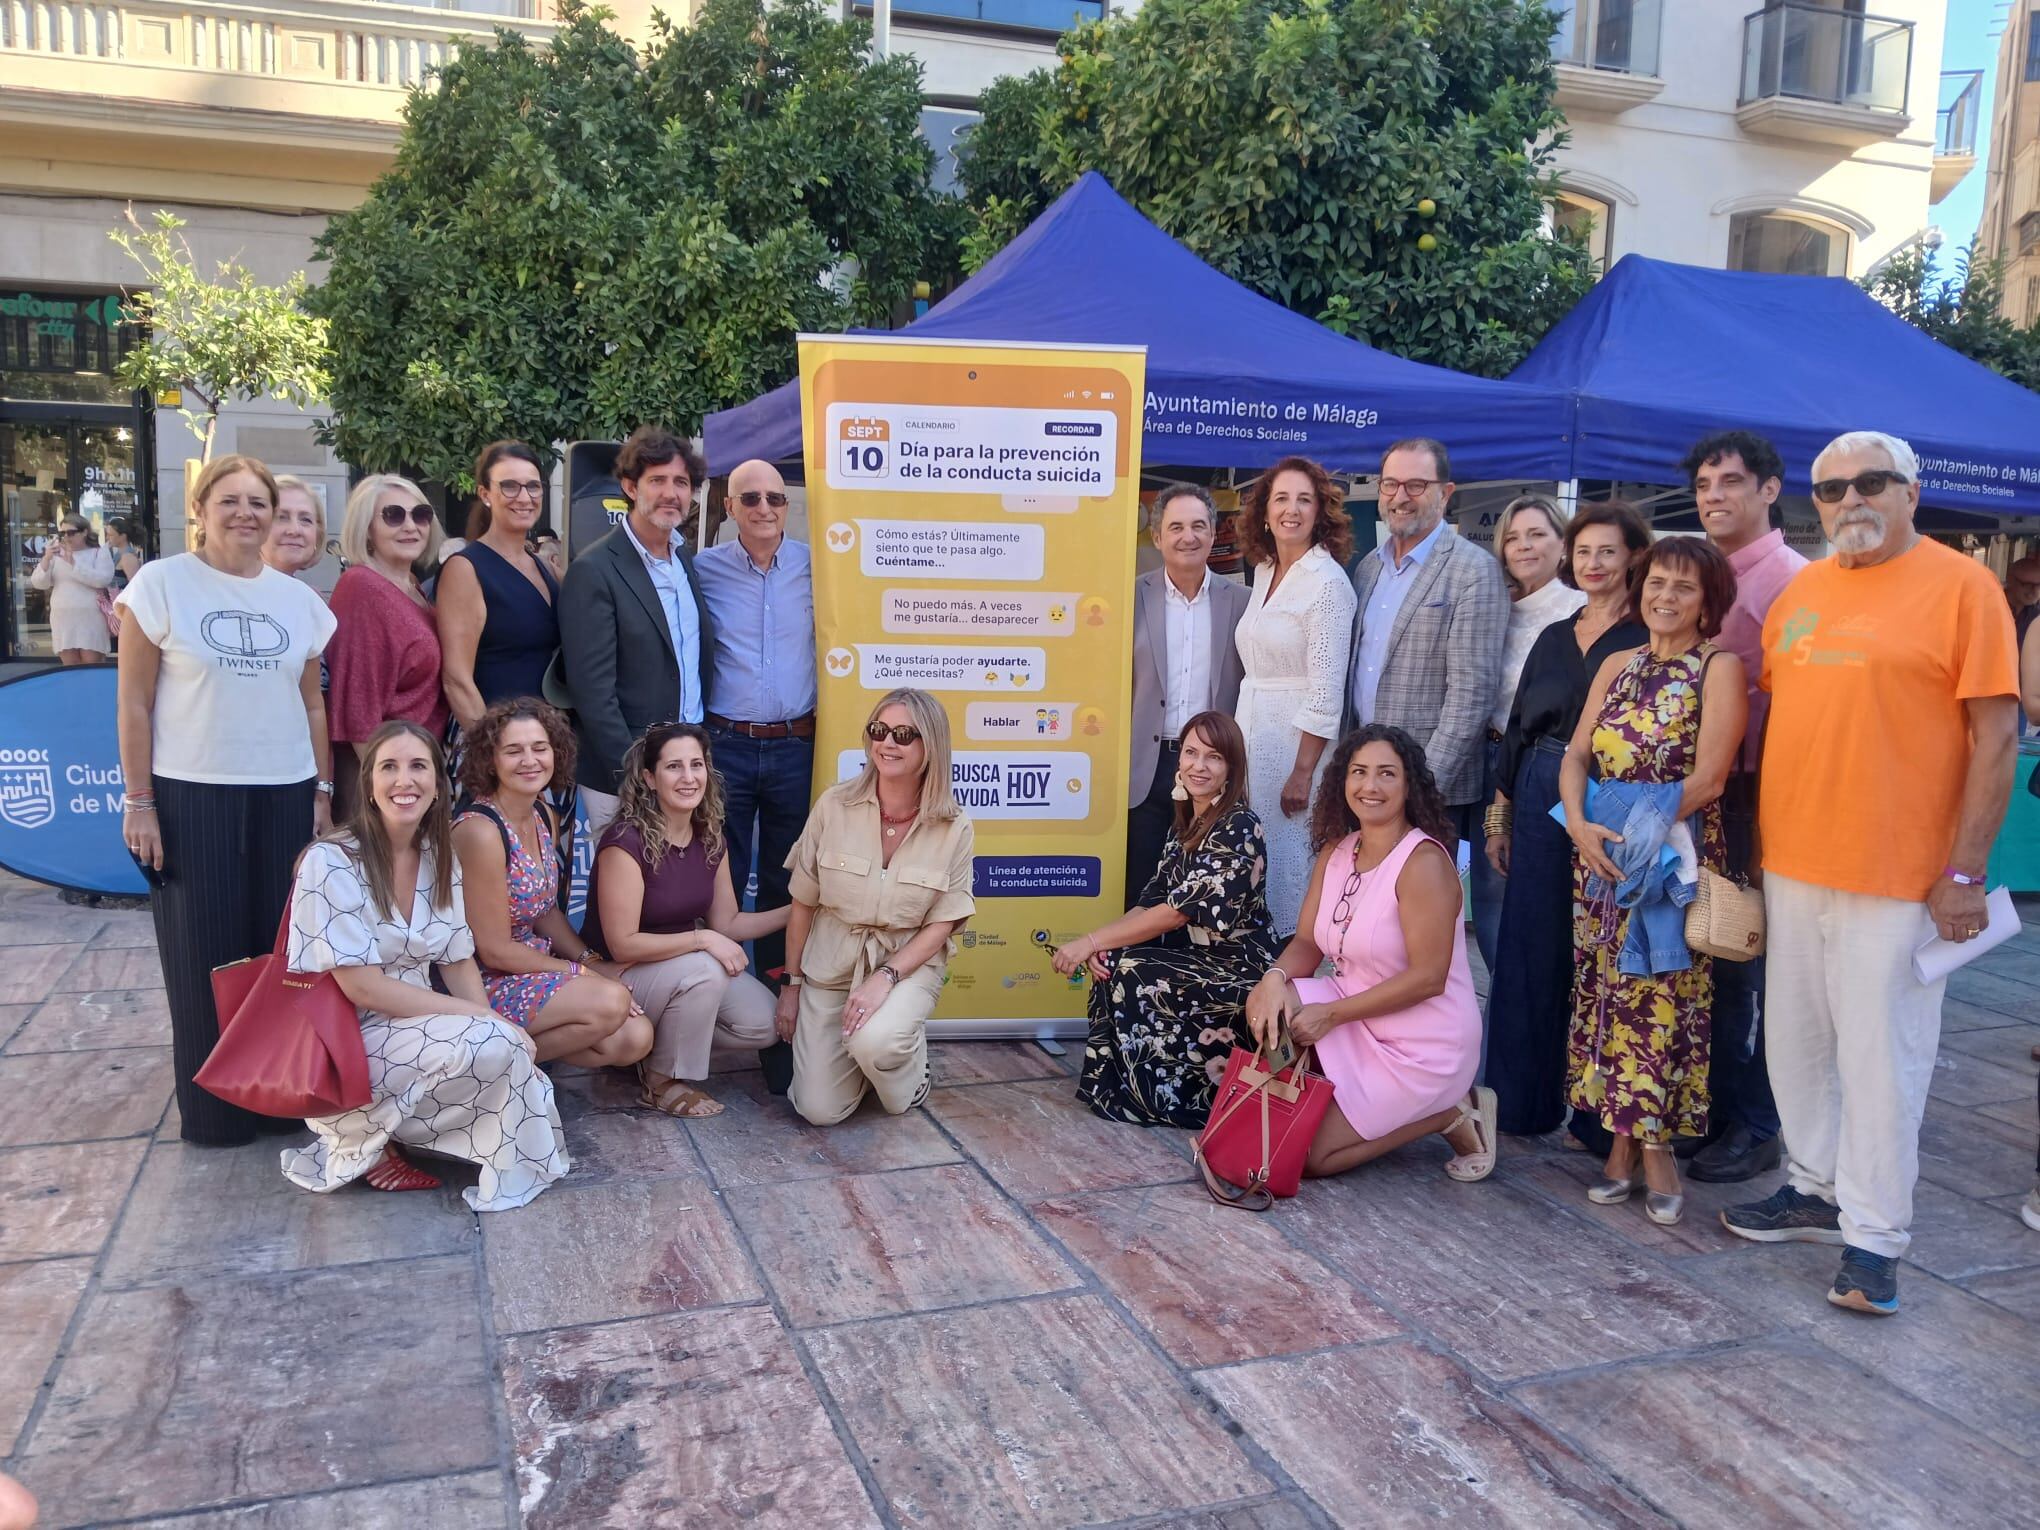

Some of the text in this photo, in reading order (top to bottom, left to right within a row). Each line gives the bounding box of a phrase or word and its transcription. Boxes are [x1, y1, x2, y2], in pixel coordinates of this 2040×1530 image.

[0, 293, 77, 319] efour
[37, 320, 75, 343] city
[1144, 391, 1378, 428] Ayuntamiento de Málaga
[847, 425, 883, 438] SEPT
[905, 421, 956, 430] CALENDARIO
[1052, 425, 1095, 434] RECORDAR
[1143, 416, 1308, 442] Área de Derechos Sociales
[846, 446, 884, 471] 10
[900, 441, 1100, 463] Día para la prevención
[900, 463, 1101, 482] de la conducta suicida
[2001, 466, 2017, 481] de
[1930, 479, 1941, 489] de
[1943, 479, 1981, 494] Derechos
[1982, 483, 2015, 498] Sociales
[875, 529, 1020, 543] Cómo estás? Últimamente
[875, 543, 1006, 558] siento que te pasa algo.
[875, 556, 945, 568] Cuéntame...
[894, 599, 1022, 611] No puedo más. A veces
[894, 613, 1039, 626] me gustaría... desaparecer
[216, 656, 281, 671] TWINSET
[874, 654, 1031, 668] Me gustaría poder ayudarte.
[874, 667, 965, 679] ¿Qué necesitas?
[983, 717, 1021, 727] Hablar
[65, 763, 127, 786] Ciud
[952, 763, 1051, 799] BUSCA HOY
[69, 792, 127, 814] de M
[952, 788, 1001, 807] AYUDA
[988, 865, 1087, 876] Línea de atención a
[989, 877, 1088, 888] la conducta suicida
[987, 939, 1007, 947] Málaga
